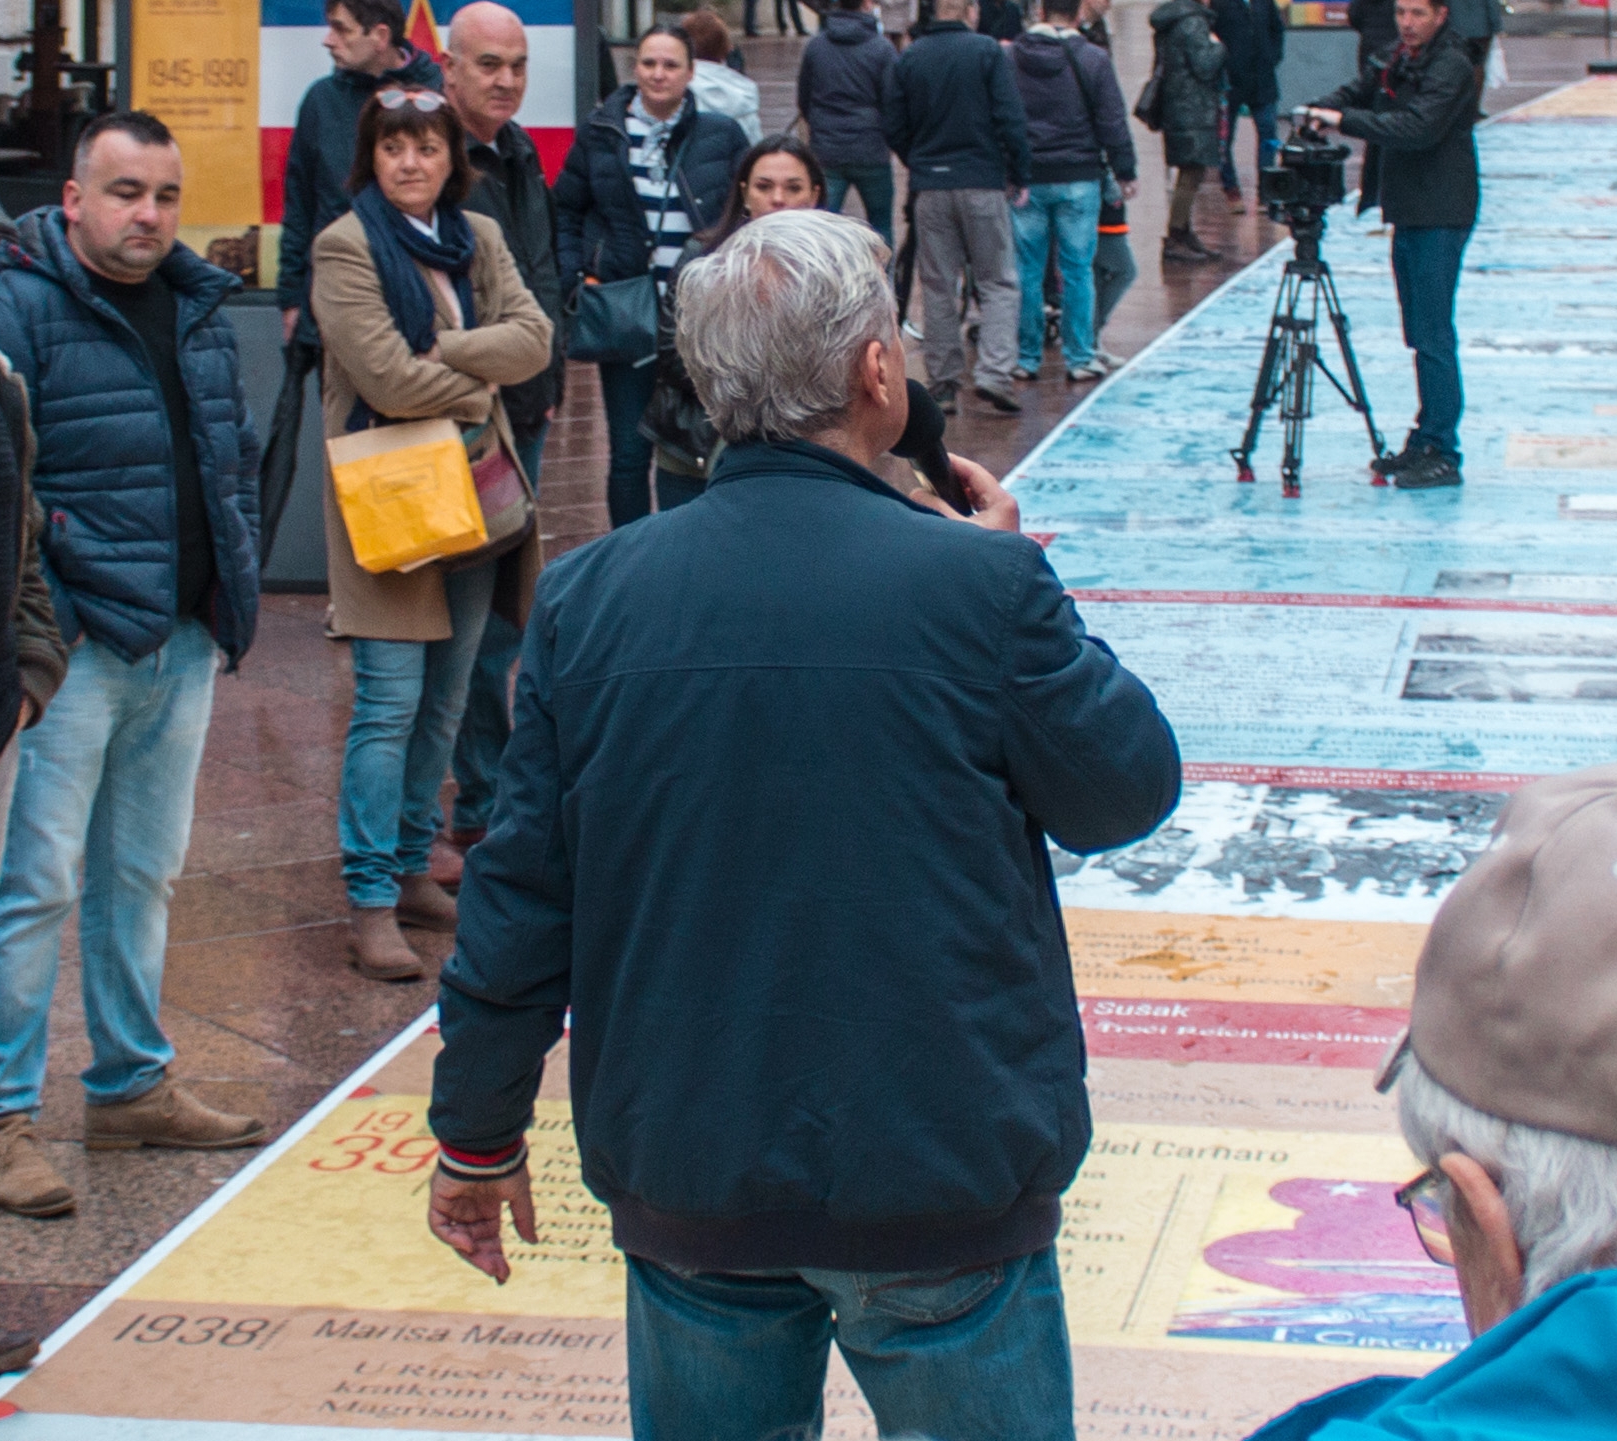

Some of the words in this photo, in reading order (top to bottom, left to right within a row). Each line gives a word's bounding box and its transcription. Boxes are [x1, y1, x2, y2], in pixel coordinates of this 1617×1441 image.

[1093, 1000, 1190, 1018] Sušak
[308, 1134, 439, 1174] 39
[1090, 1139, 1141, 1157] del
[312, 1317, 450, 1343] Marisa
[460, 1323, 620, 1351] Madieri
[333, 1379, 488, 1400] kratkom
